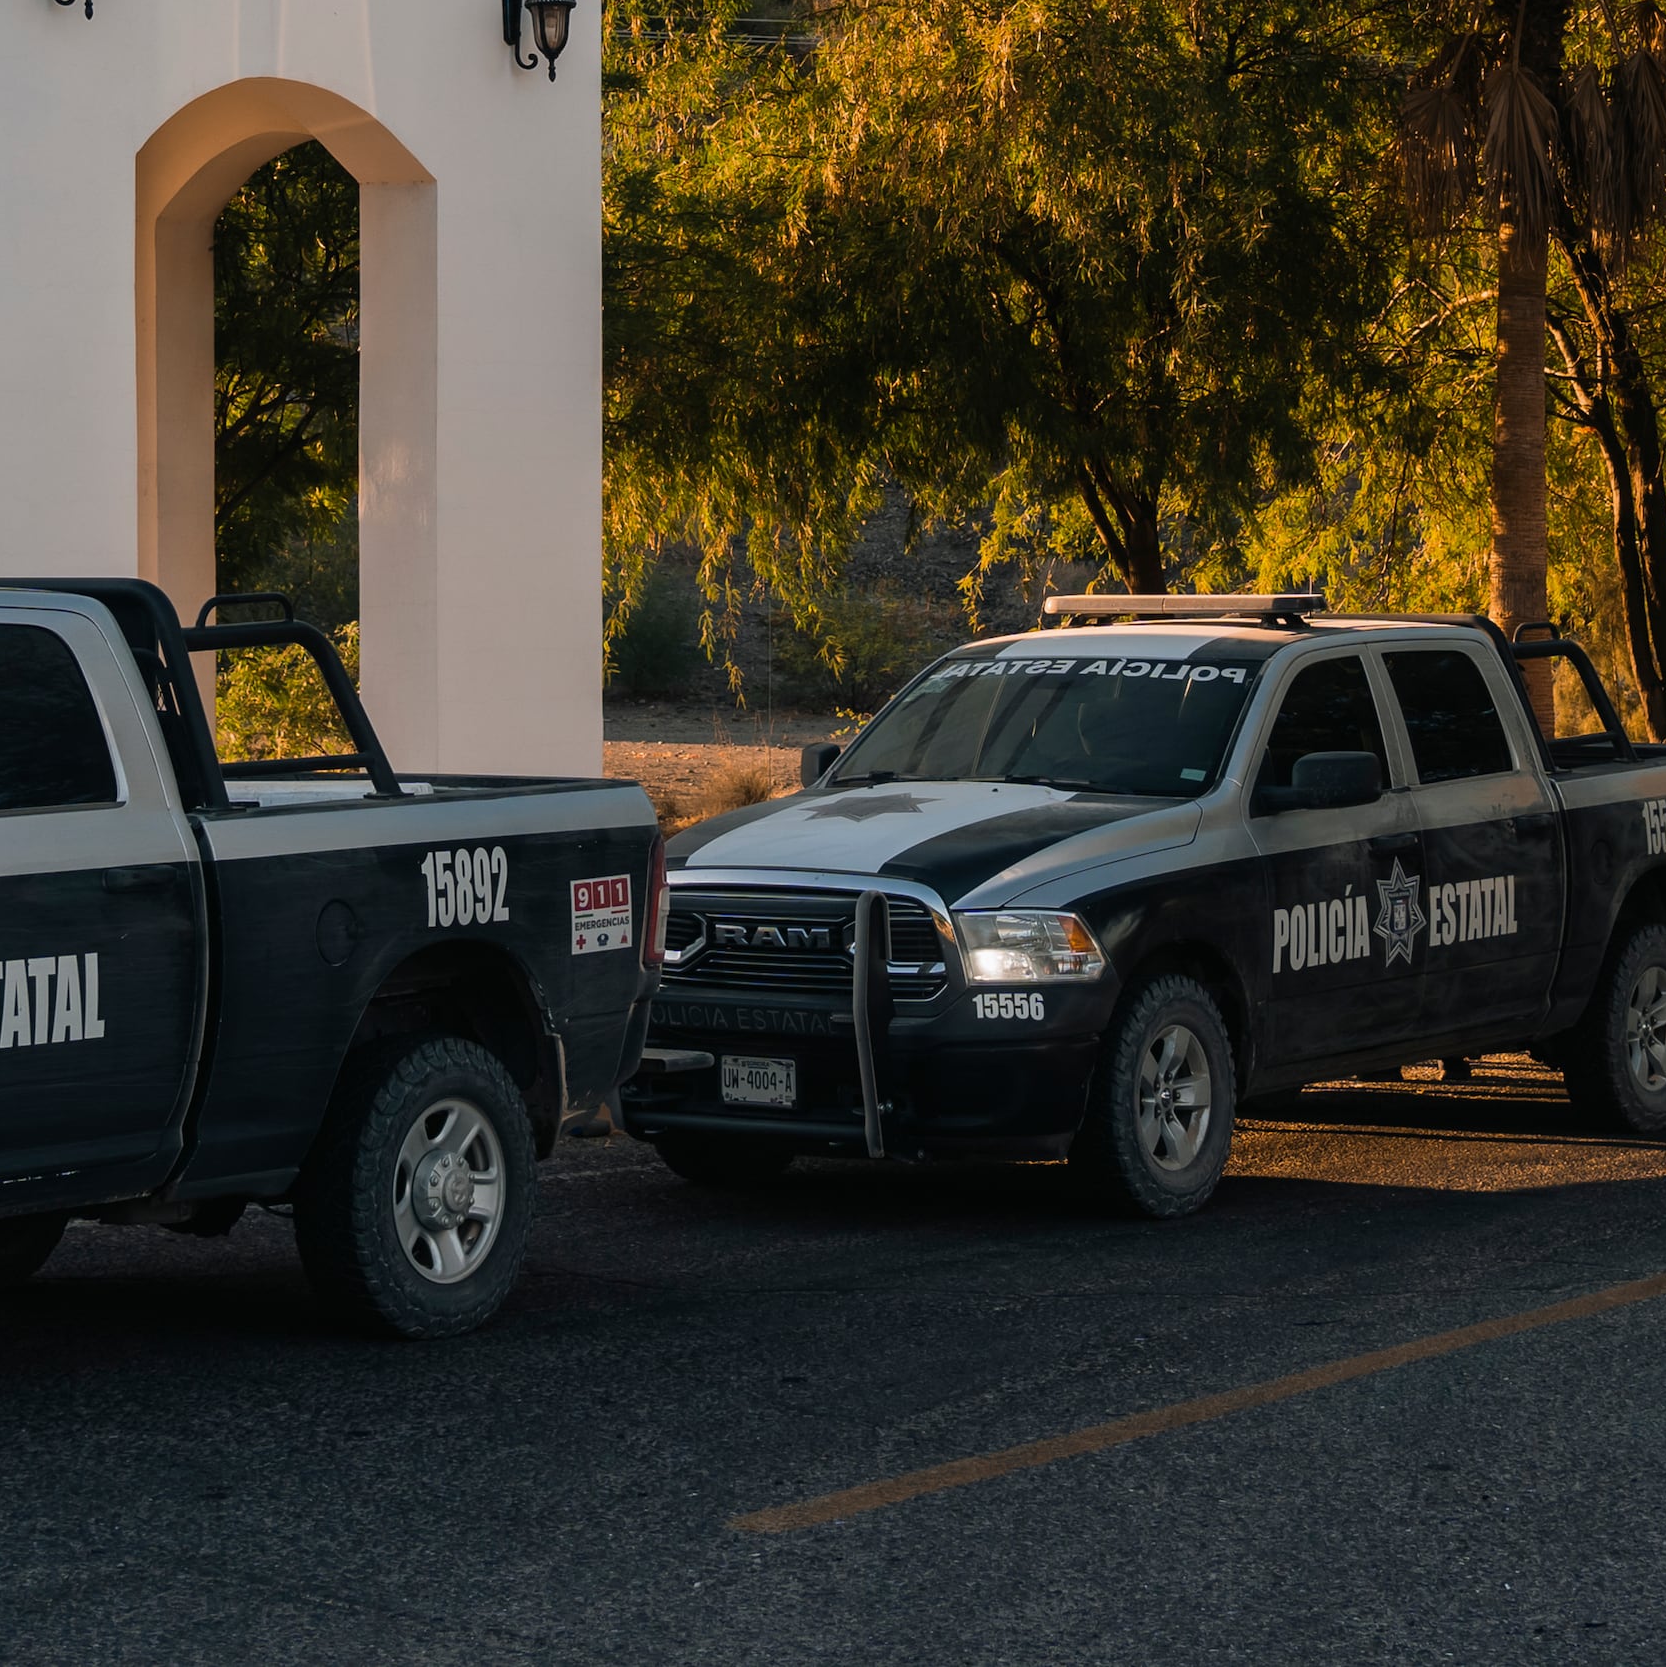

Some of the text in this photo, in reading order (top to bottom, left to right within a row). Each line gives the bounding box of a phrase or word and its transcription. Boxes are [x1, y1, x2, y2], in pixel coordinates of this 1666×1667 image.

[421, 846, 510, 928] 15892
[577, 882, 624, 908] 911
[574, 916, 630, 932] EMERGENCIAS
[715, 923, 830, 949] RAM
[1272, 875, 1518, 974] POLICÍA ESTATAL
[650, 1004, 729, 1030] OLICIA
[971, 993, 1045, 1021] 15556
